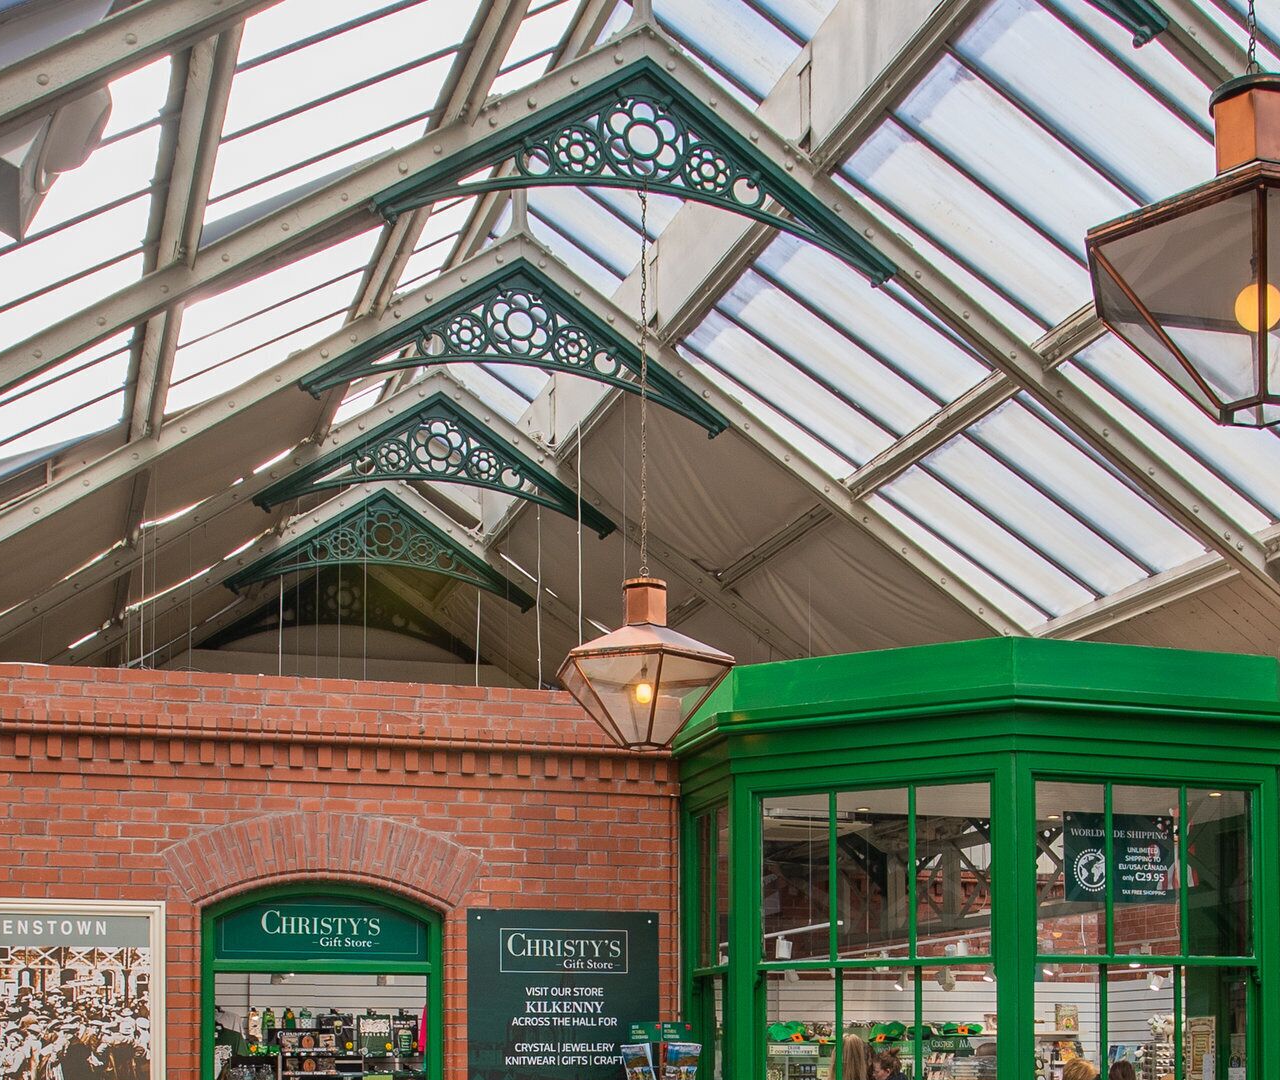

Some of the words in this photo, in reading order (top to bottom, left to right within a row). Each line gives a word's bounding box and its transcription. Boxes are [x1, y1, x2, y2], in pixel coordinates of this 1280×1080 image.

[1070, 828, 1125, 838] WORLDDE
[1126, 830, 1168, 840] SHIPPING
[1125, 855, 1153, 863] SHIPPING
[1118, 863, 1168, 871] EU/USA/CANADA
[1122, 874, 1134, 882] only
[319, 937, 342, 947] Gift
[344, 937, 372, 947] Store
[563, 959, 584, 969] Gift
[586, 959, 614, 969] Store
[525, 987, 549, 996] VISIT
[550, 987, 571, 996] OUR
[573, 987, 604, 997] STORE
[525, 1001, 604, 1014] KILKENNY
[512, 1016, 550, 1026] ACROSS
[552, 1017, 571, 1026] THE
[572, 1017, 597, 1026] HALL
[598, 1017, 618, 1027] FOR
[514, 1043, 556, 1052] CRYSTAL
[561, 1043, 615, 1053] JEWELLERY
[505, 1056, 556, 1065] KNITWEAR
[561, 1056, 588, 1065] GIFTS
